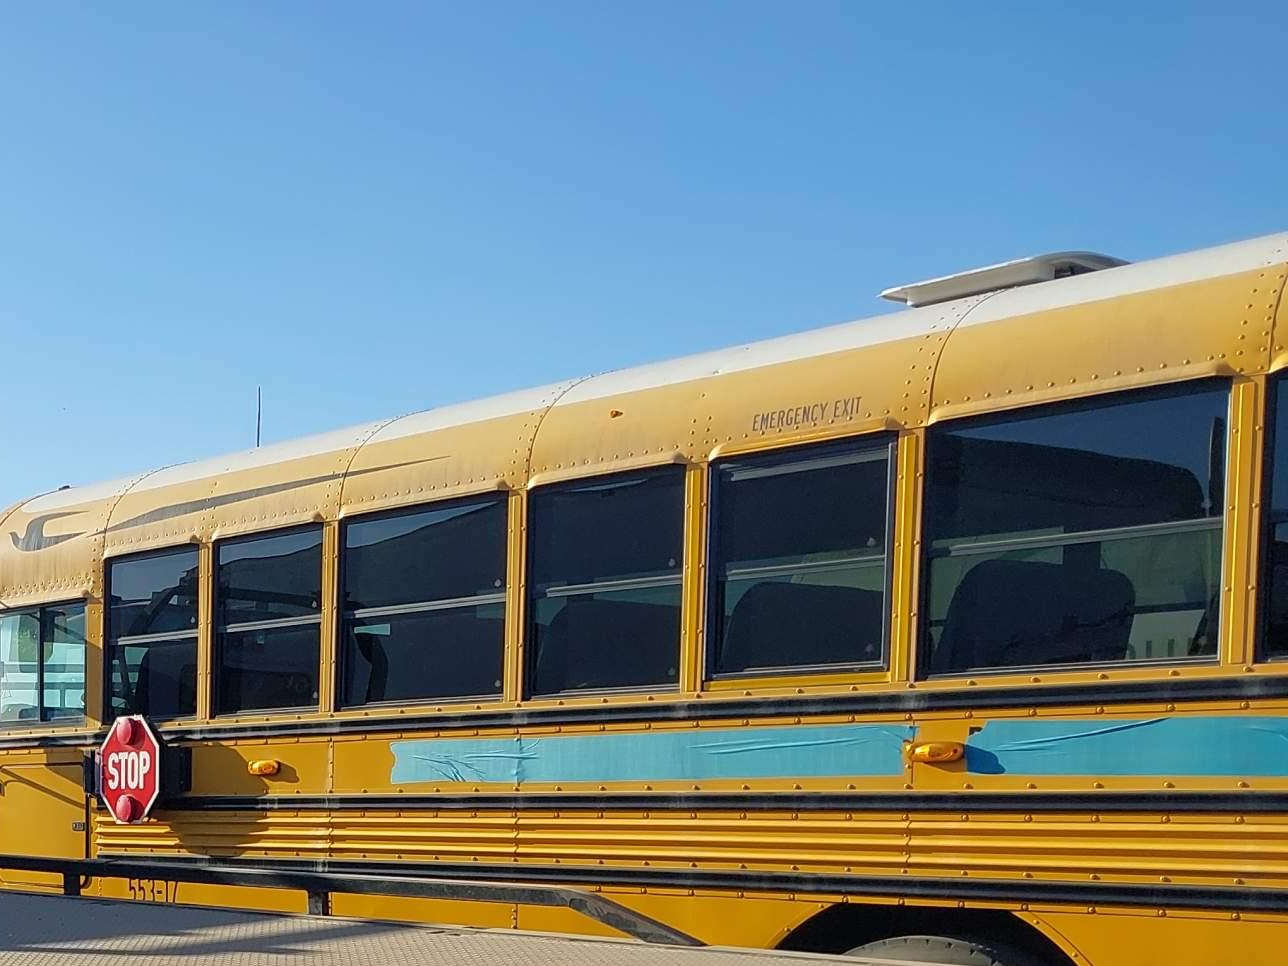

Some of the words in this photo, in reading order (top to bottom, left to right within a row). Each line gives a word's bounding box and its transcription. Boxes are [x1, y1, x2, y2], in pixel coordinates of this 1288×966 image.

[752, 402, 829, 432] EMERGENCY
[833, 396, 862, 418] EXIT
[107, 750, 151, 790] STOP
